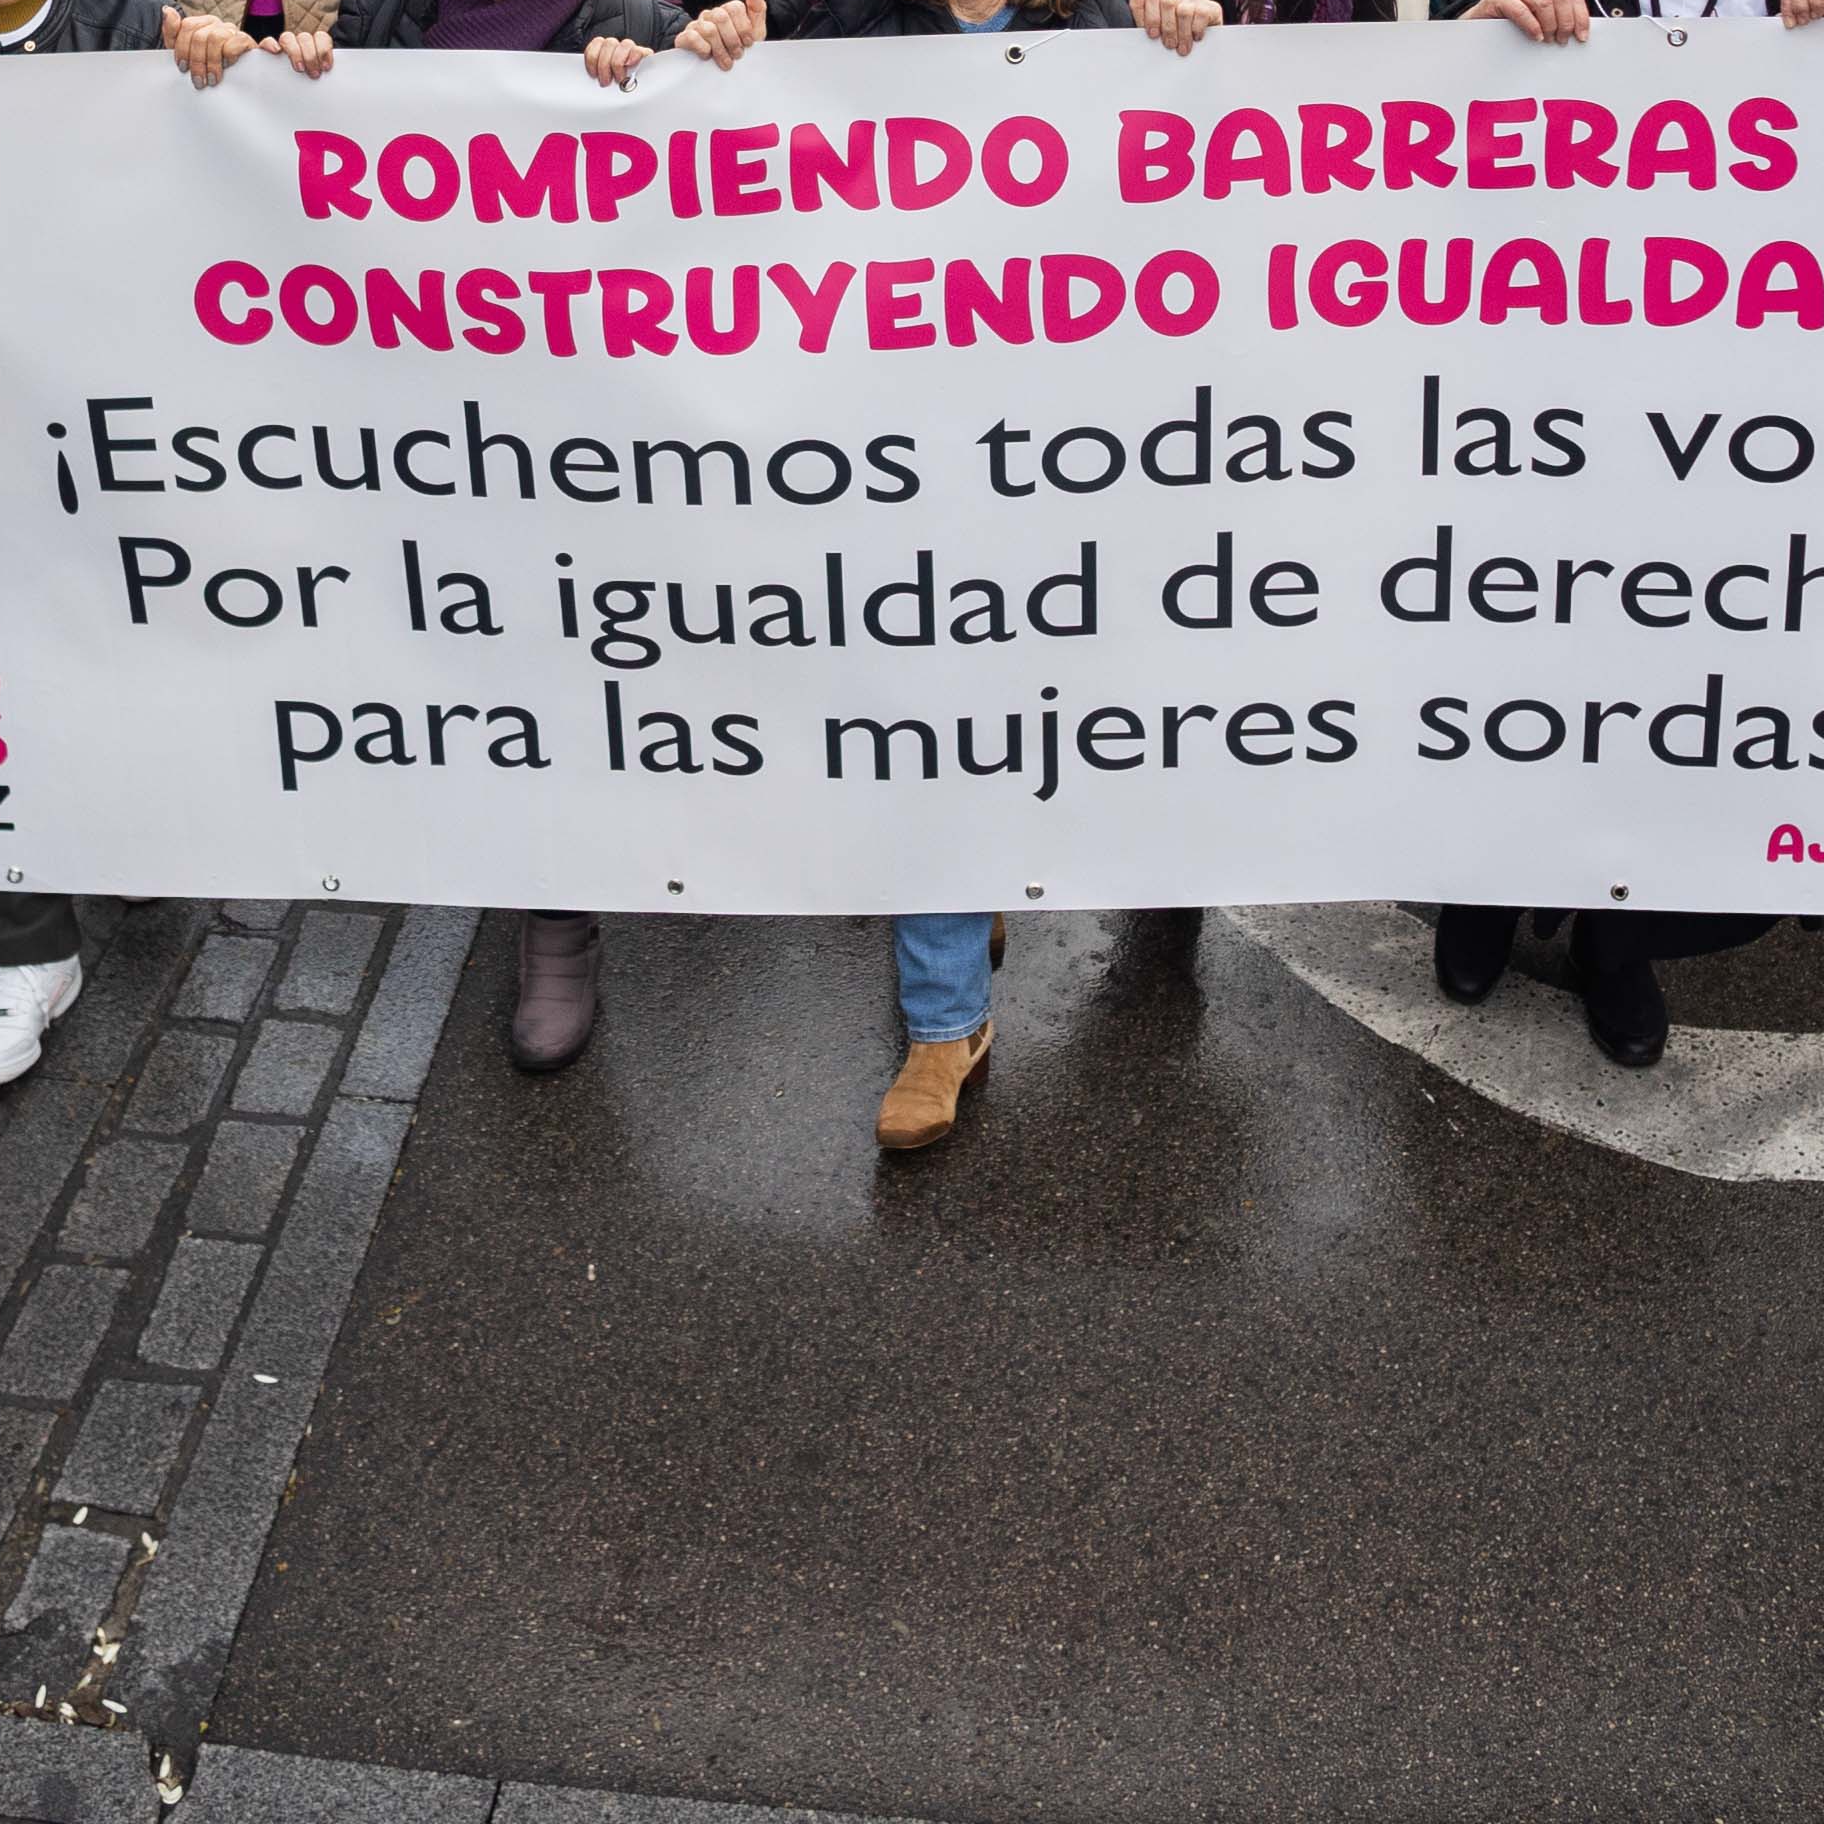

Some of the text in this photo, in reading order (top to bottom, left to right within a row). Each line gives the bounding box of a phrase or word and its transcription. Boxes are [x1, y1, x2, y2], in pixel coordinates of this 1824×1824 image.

[294, 97, 1797, 223] ROMPIENDO BARRERAS
[195, 250, 1220, 358] CONSTRUYENDO
[47, 397, 919, 511] ¡Escuchemos
[976, 386, 1354, 496] todas
[1423, 376, 1585, 476] las
[119, 537, 350, 627] Por
[403, 540, 503, 635] la
[556, 542, 1096, 669] igualdad
[1163, 532, 1318, 628] de
[276, 701, 550, 790] para
[605, 681, 763, 775] las
[826, 687, 1357, 801] mujeres
